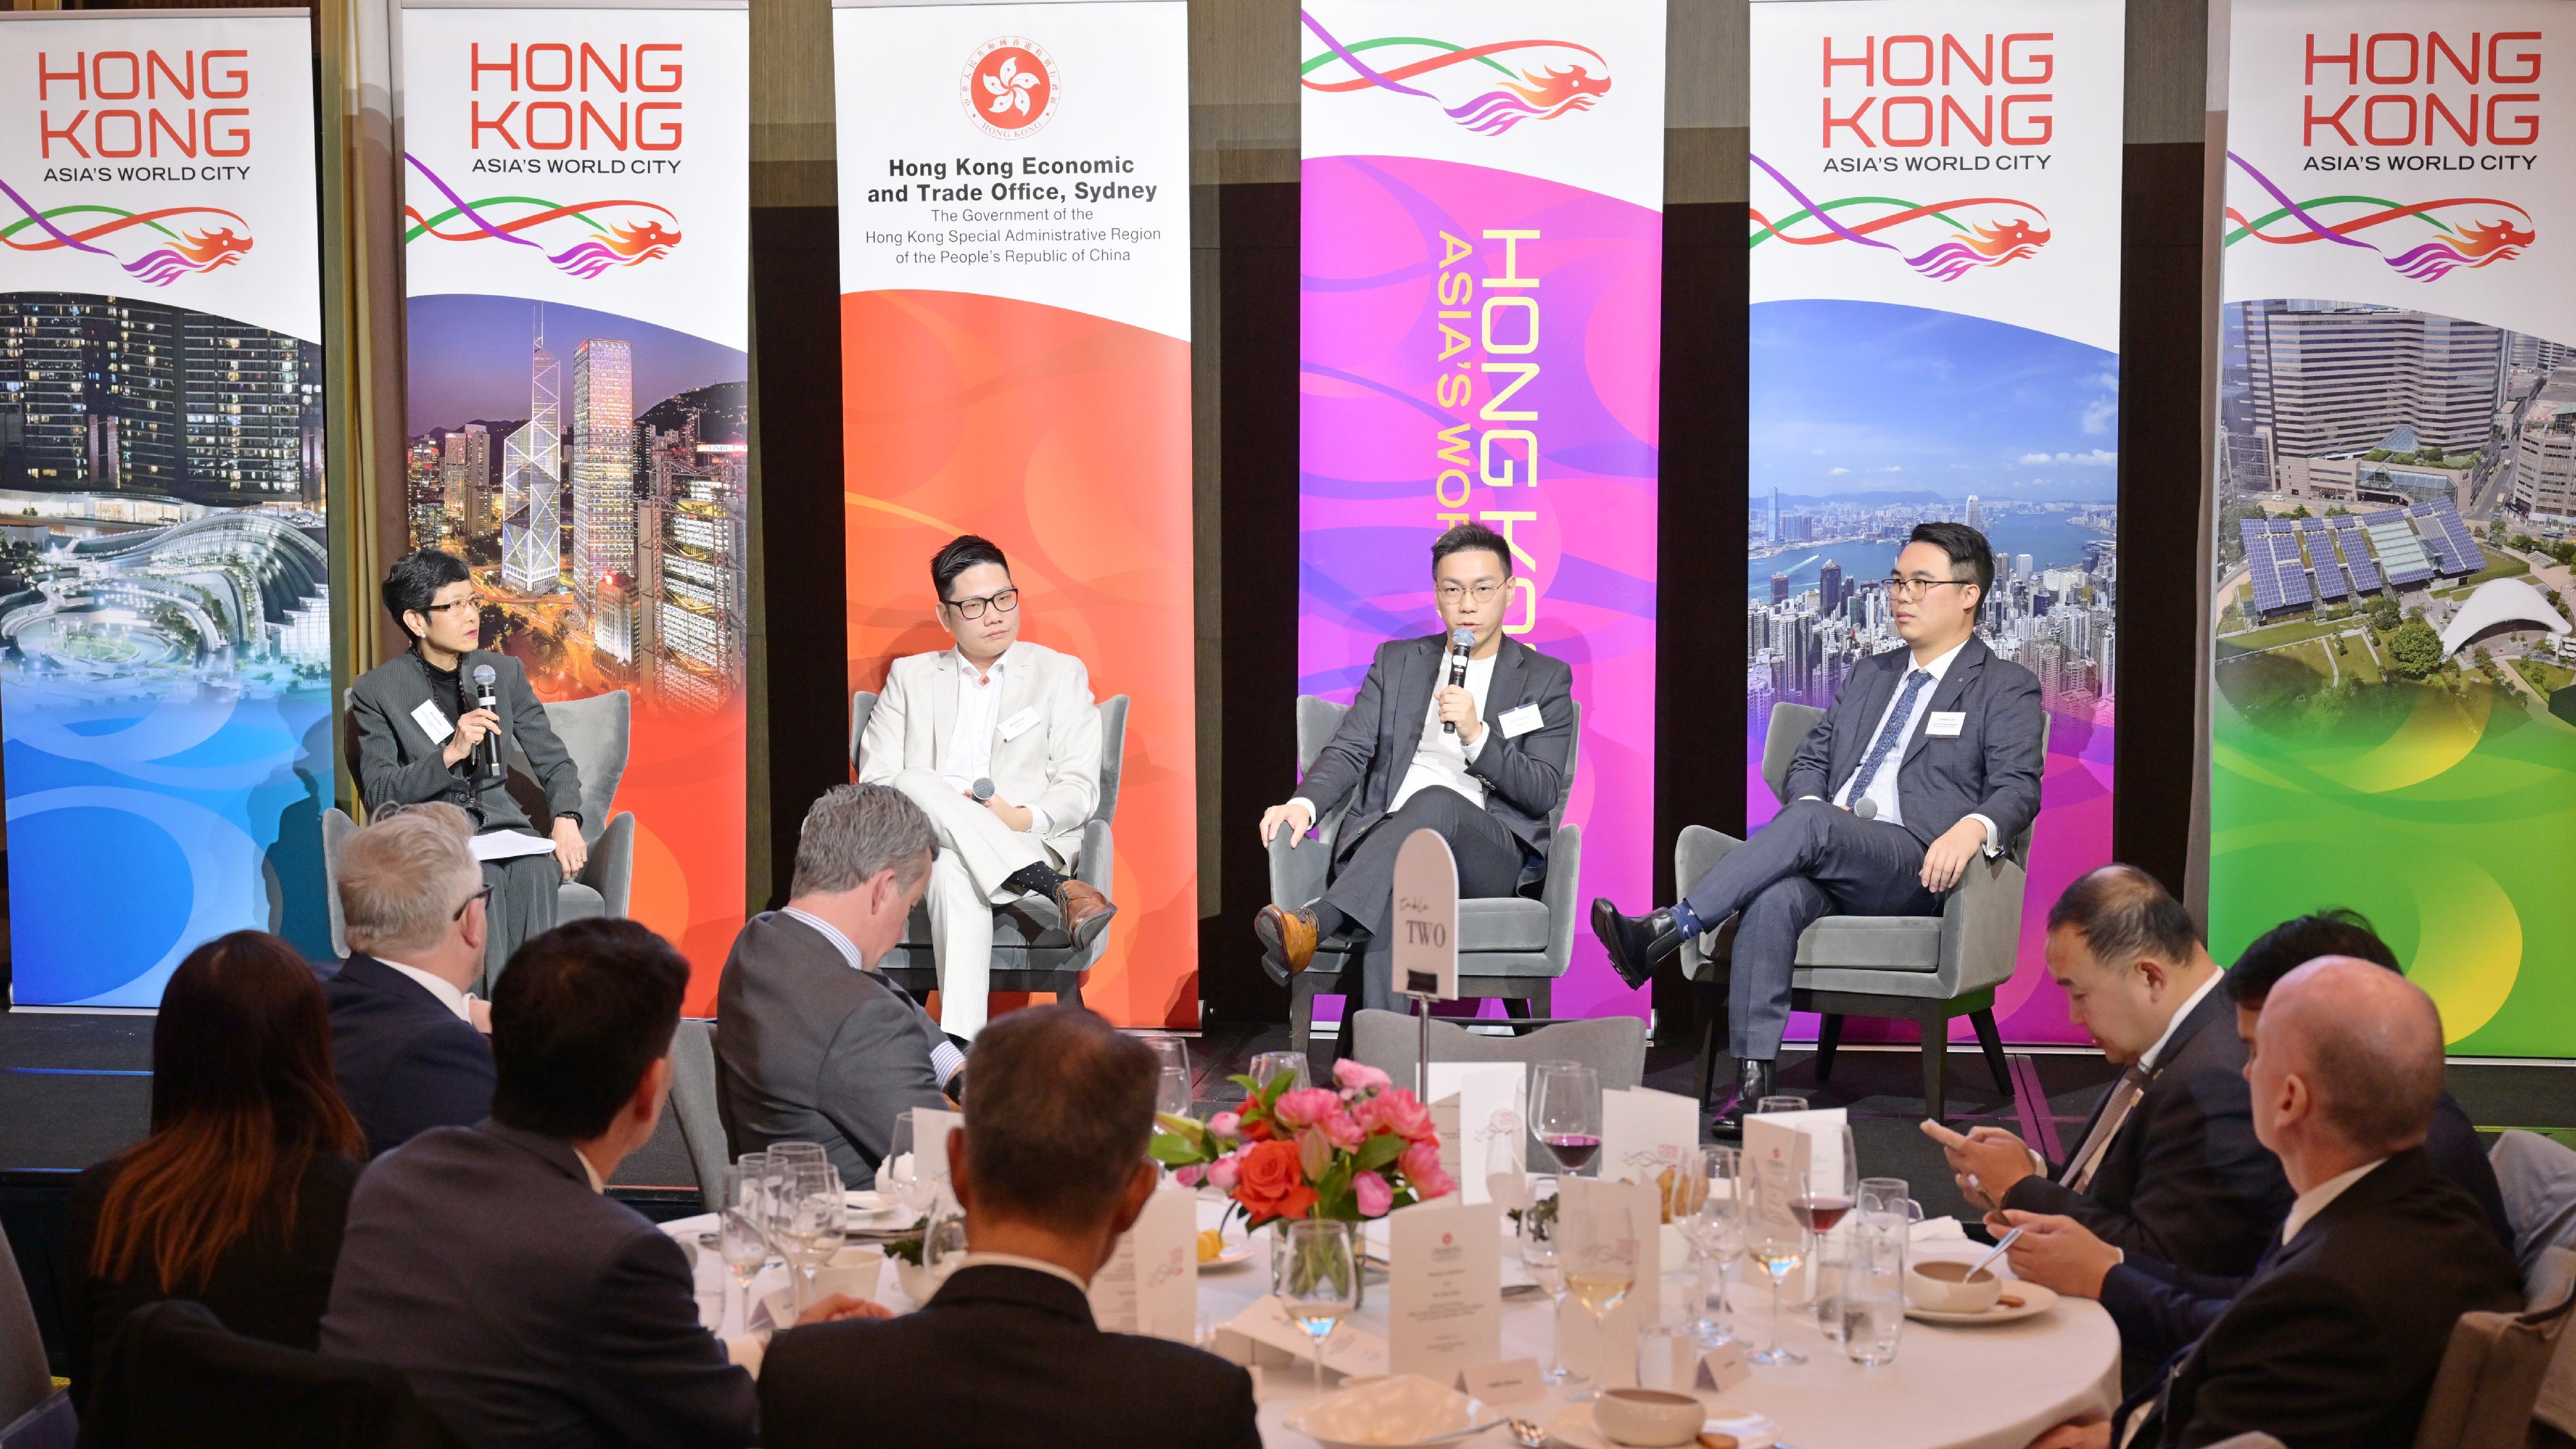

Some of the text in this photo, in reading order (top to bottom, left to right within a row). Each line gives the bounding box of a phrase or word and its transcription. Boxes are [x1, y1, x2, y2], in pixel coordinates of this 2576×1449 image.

[471, 42, 683, 93] HONG
[1823, 33, 2054, 88] HONG
[2304, 31, 2543, 88] HONG
[39, 50, 249, 101] HONG
[41, 108, 251, 159] KONG
[471, 100, 683, 152] KONG
[981, 120, 1042, 138] HONG KONG
[1823, 94, 2053, 149] KONG
[2304, 93, 2541, 147] KONG
[44, 166, 251, 182] ASIA'S WORLD CITY
[472, 158, 682, 175] ASIA'S WORLD CITY
[889, 155, 1135, 180] Hong Kong Economic
[1823, 155, 2052, 173] ASIA'S WORLD CITY
[2303, 155, 2538, 171] ASIA'S WORLD CITY
[868, 181, 1157, 204] and Trade Office, Sydney
[931, 207, 1094, 222] The Government of the
[866, 227, 1160, 247] Hong Kong Special Administrative Region
[896, 248, 1131, 265] of the People's Republic of China
[1437, 231, 1473, 408] ASIA'S
[1479, 229, 1540, 486] HONG
[1405, 920, 1446, 949] TWO
